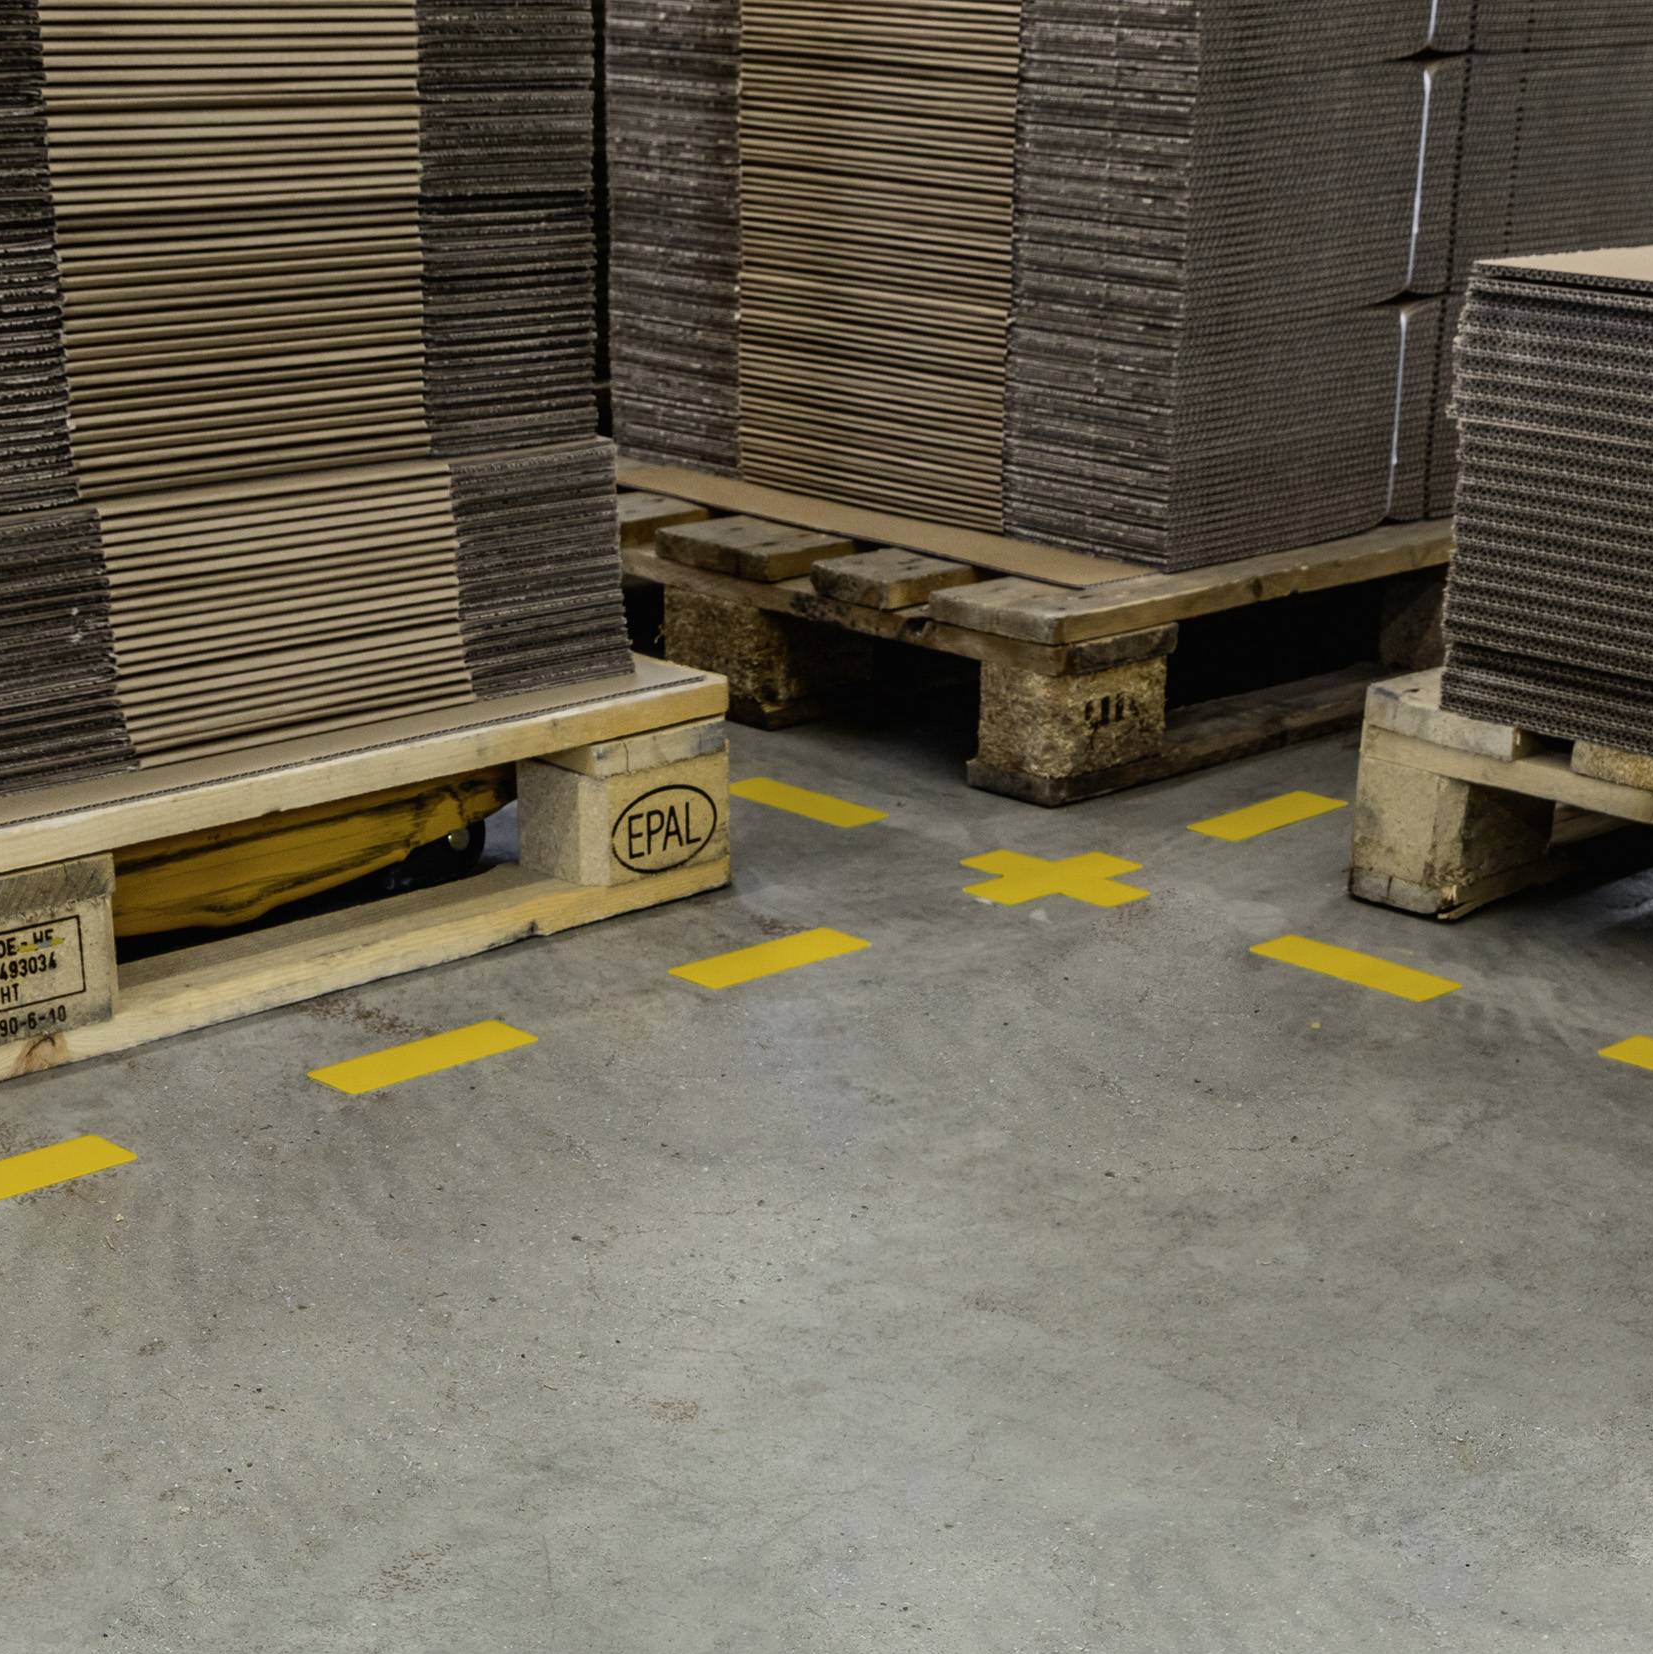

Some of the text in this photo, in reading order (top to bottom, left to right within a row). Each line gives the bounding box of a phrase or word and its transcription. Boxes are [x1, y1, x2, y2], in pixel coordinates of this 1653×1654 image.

[628, 802, 701, 859] EPAL
[0, 952, 57, 980] 493034
[0, 983, 19, 1004] HT
